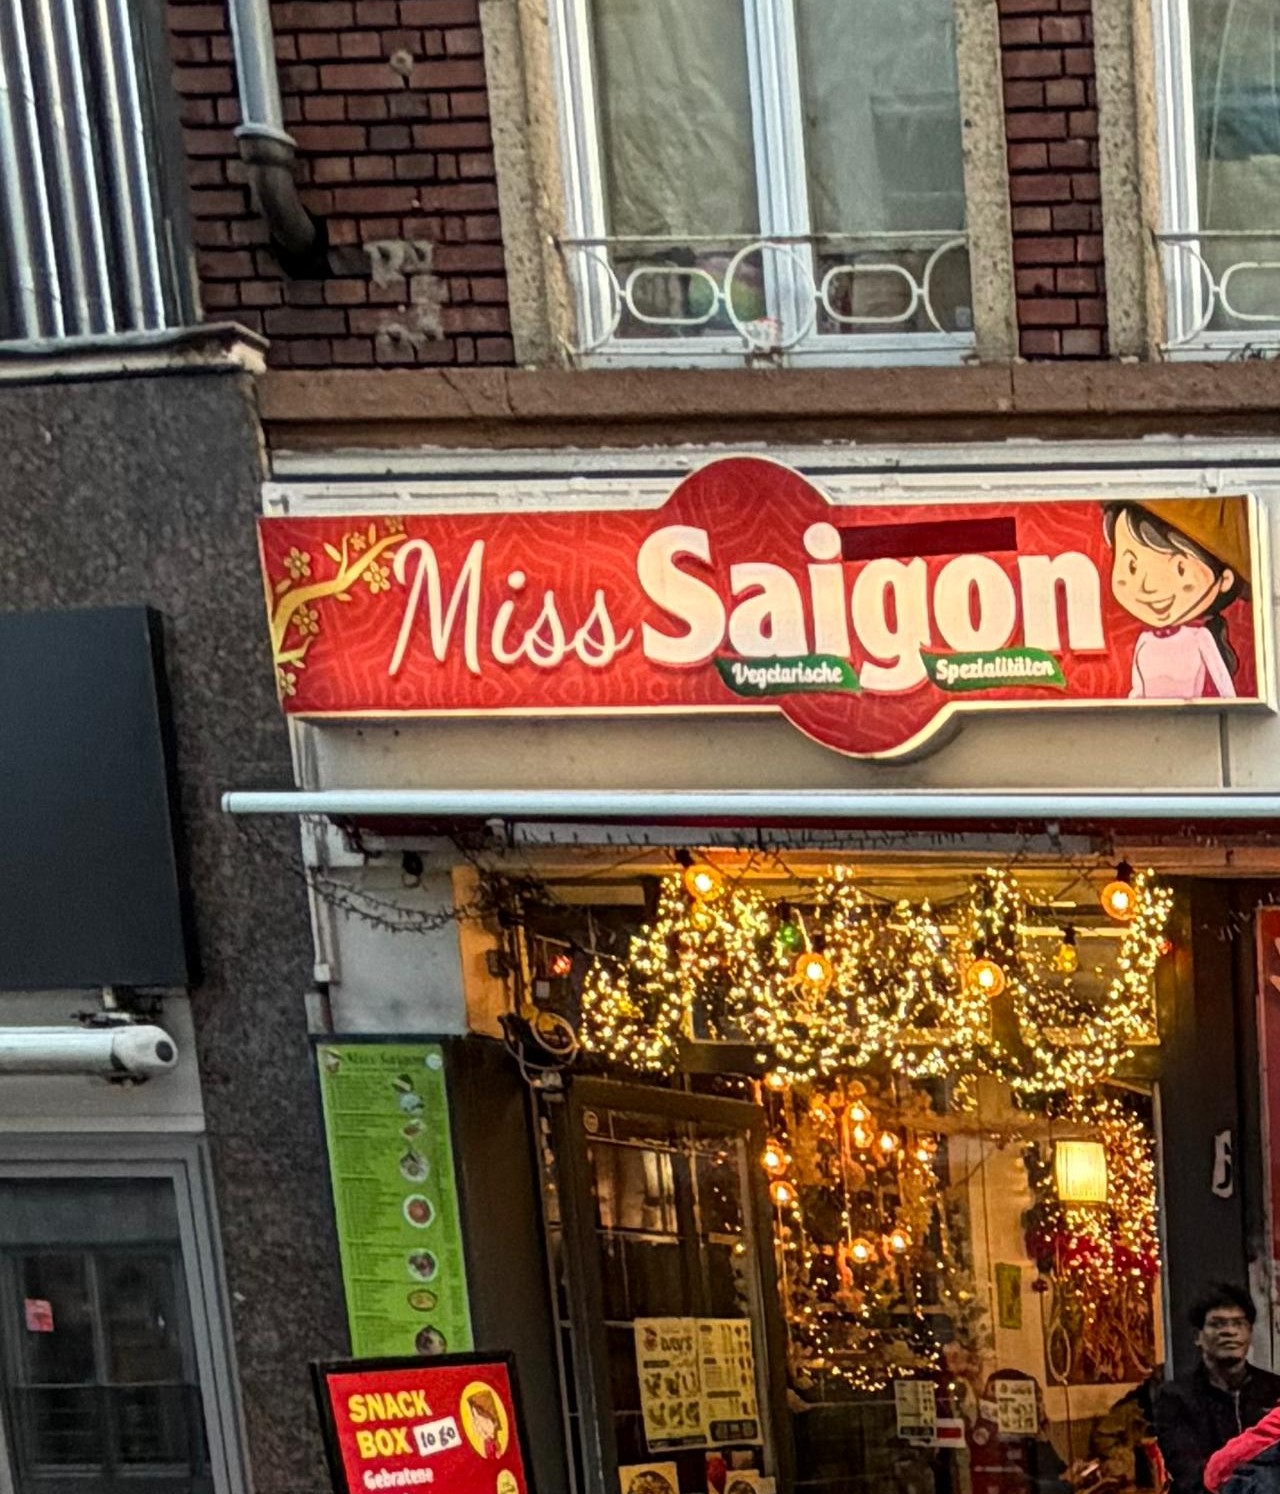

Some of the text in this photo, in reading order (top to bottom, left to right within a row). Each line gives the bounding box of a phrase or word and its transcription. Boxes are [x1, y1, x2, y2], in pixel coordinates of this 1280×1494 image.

[394, 523, 1104, 692] Miss Saigon
[731, 657, 1055, 688] Vegetarische Spezialitäten
[348, 1389, 433, 1423] SNACK
[356, 1427, 413, 1459] BOX
[439, 1426, 456, 1447] go
[363, 1467, 434, 1491] Gebratene
